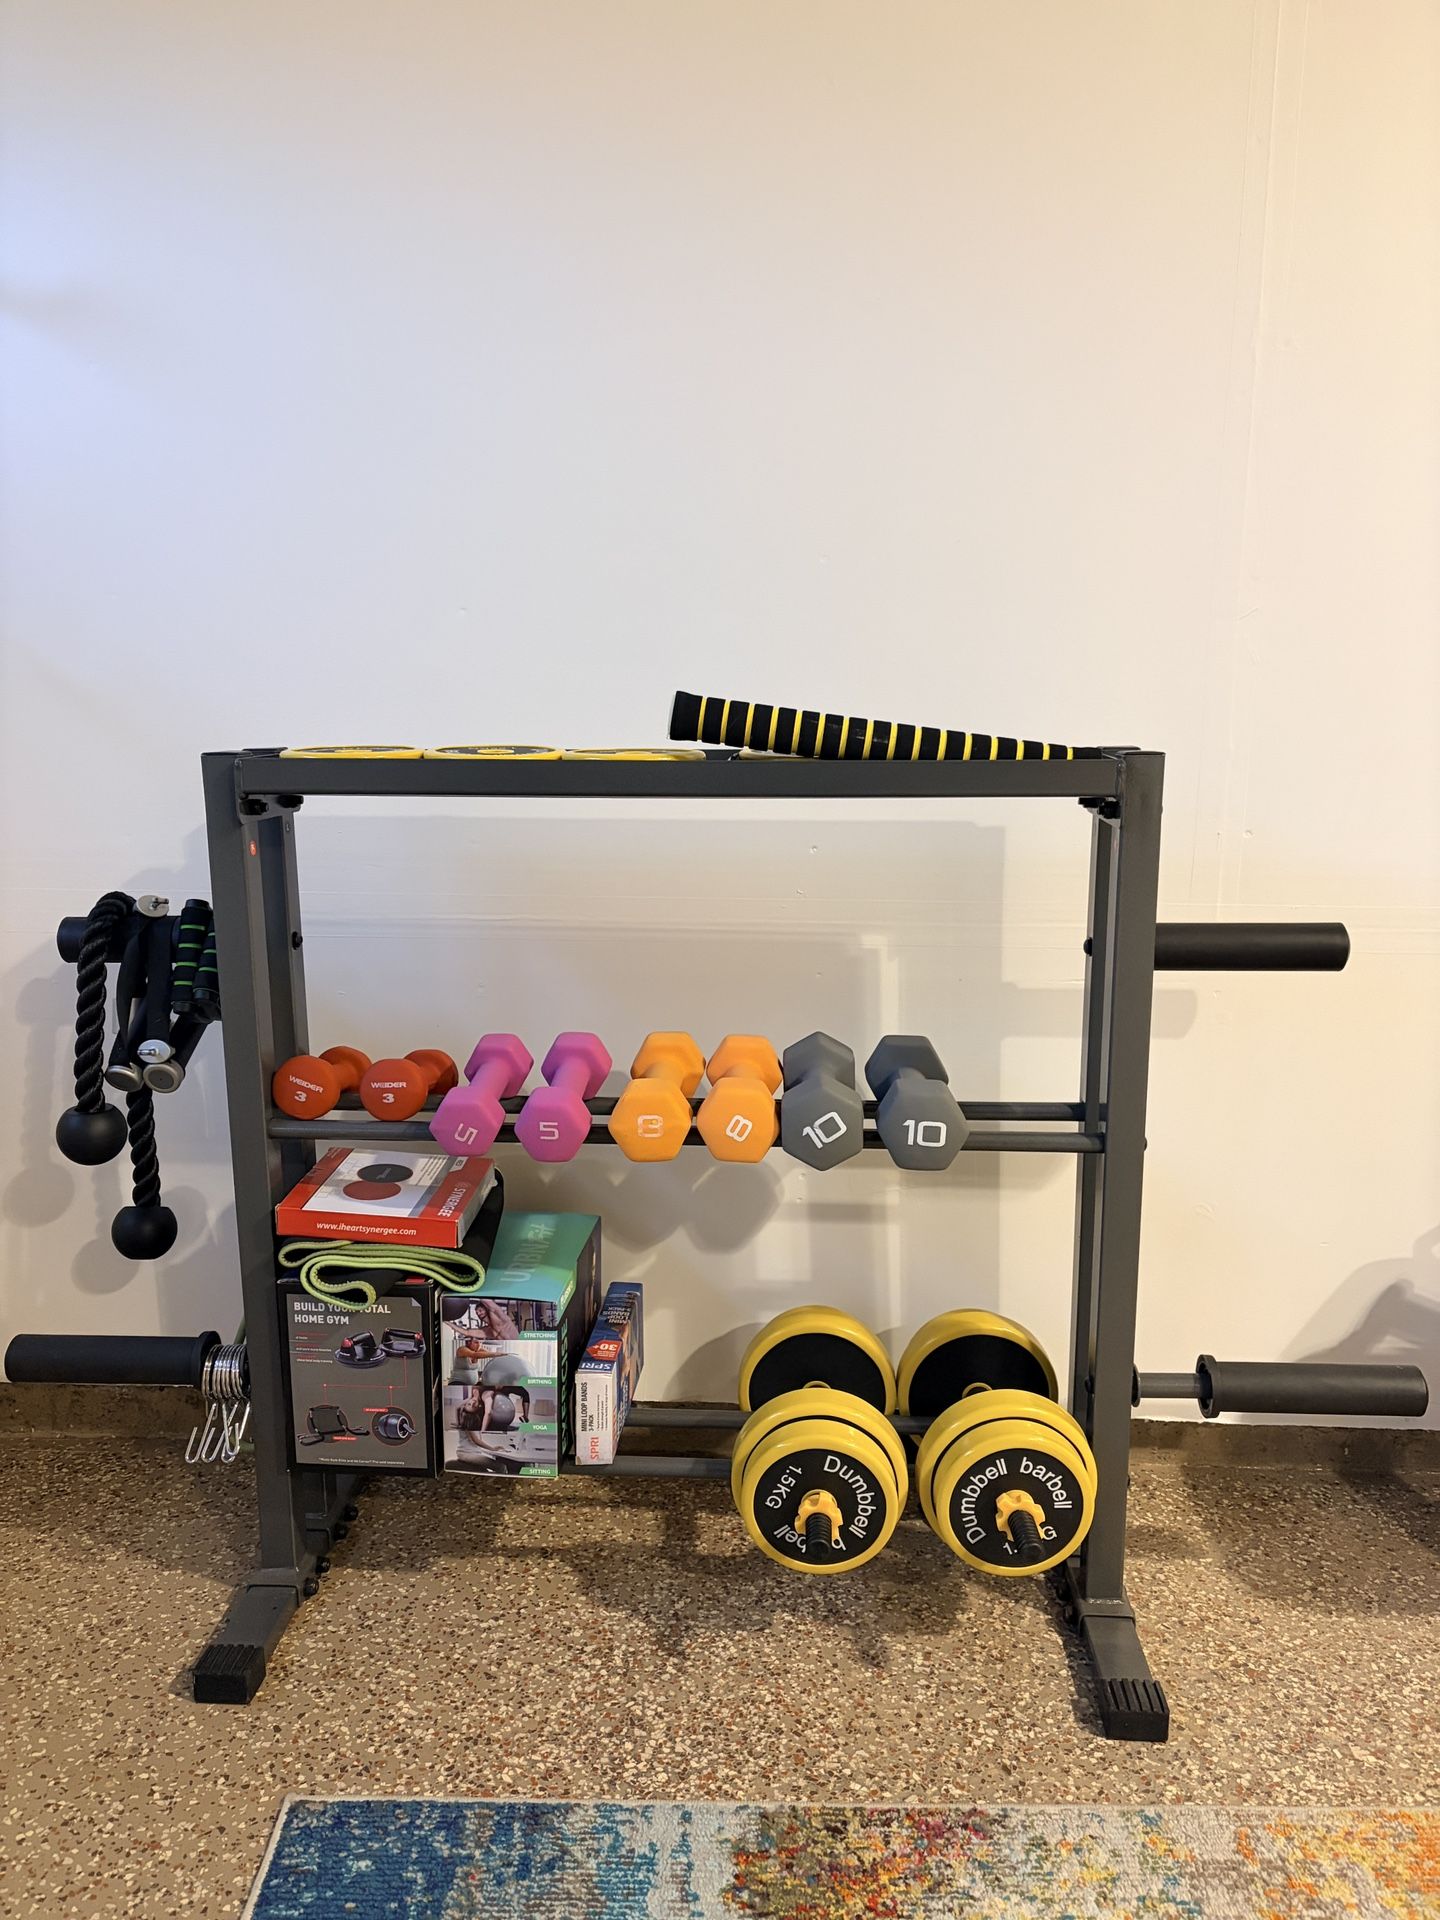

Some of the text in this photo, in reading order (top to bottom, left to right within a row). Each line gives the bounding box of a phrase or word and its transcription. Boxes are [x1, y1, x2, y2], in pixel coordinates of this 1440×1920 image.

[289, 1075, 324, 1093] WEIDER
[371, 1081, 407, 1089] WEIDER
[294, 1091, 307, 1102] 3
[382, 1093, 395, 1103] 3
[454, 1123, 478, 1145] 5
[539, 1121, 559, 1140] 5
[725, 1114, 752, 1142] 8
[802, 1111, 847, 1149] 10
[903, 1119, 947, 1147] 10
[437, 1187, 467, 1217] SYNERGEE
[316, 1222, 417, 1236] www.iheartsynergee.com
[293, 1302, 325, 1312] BUILD
[294, 1314, 350, 1325] HOME GYM
[581, 1362, 612, 1370] SPRI
[590, 1437, 599, 1460] SPRI
[765, 1465, 802, 1509] 1.5KG
[773, 1455, 877, 1553] Dumbbell bbell
[961, 1457, 1073, 1544] Dumbbell barbell
[1002, 1525, 1058, 1555] 1.G
